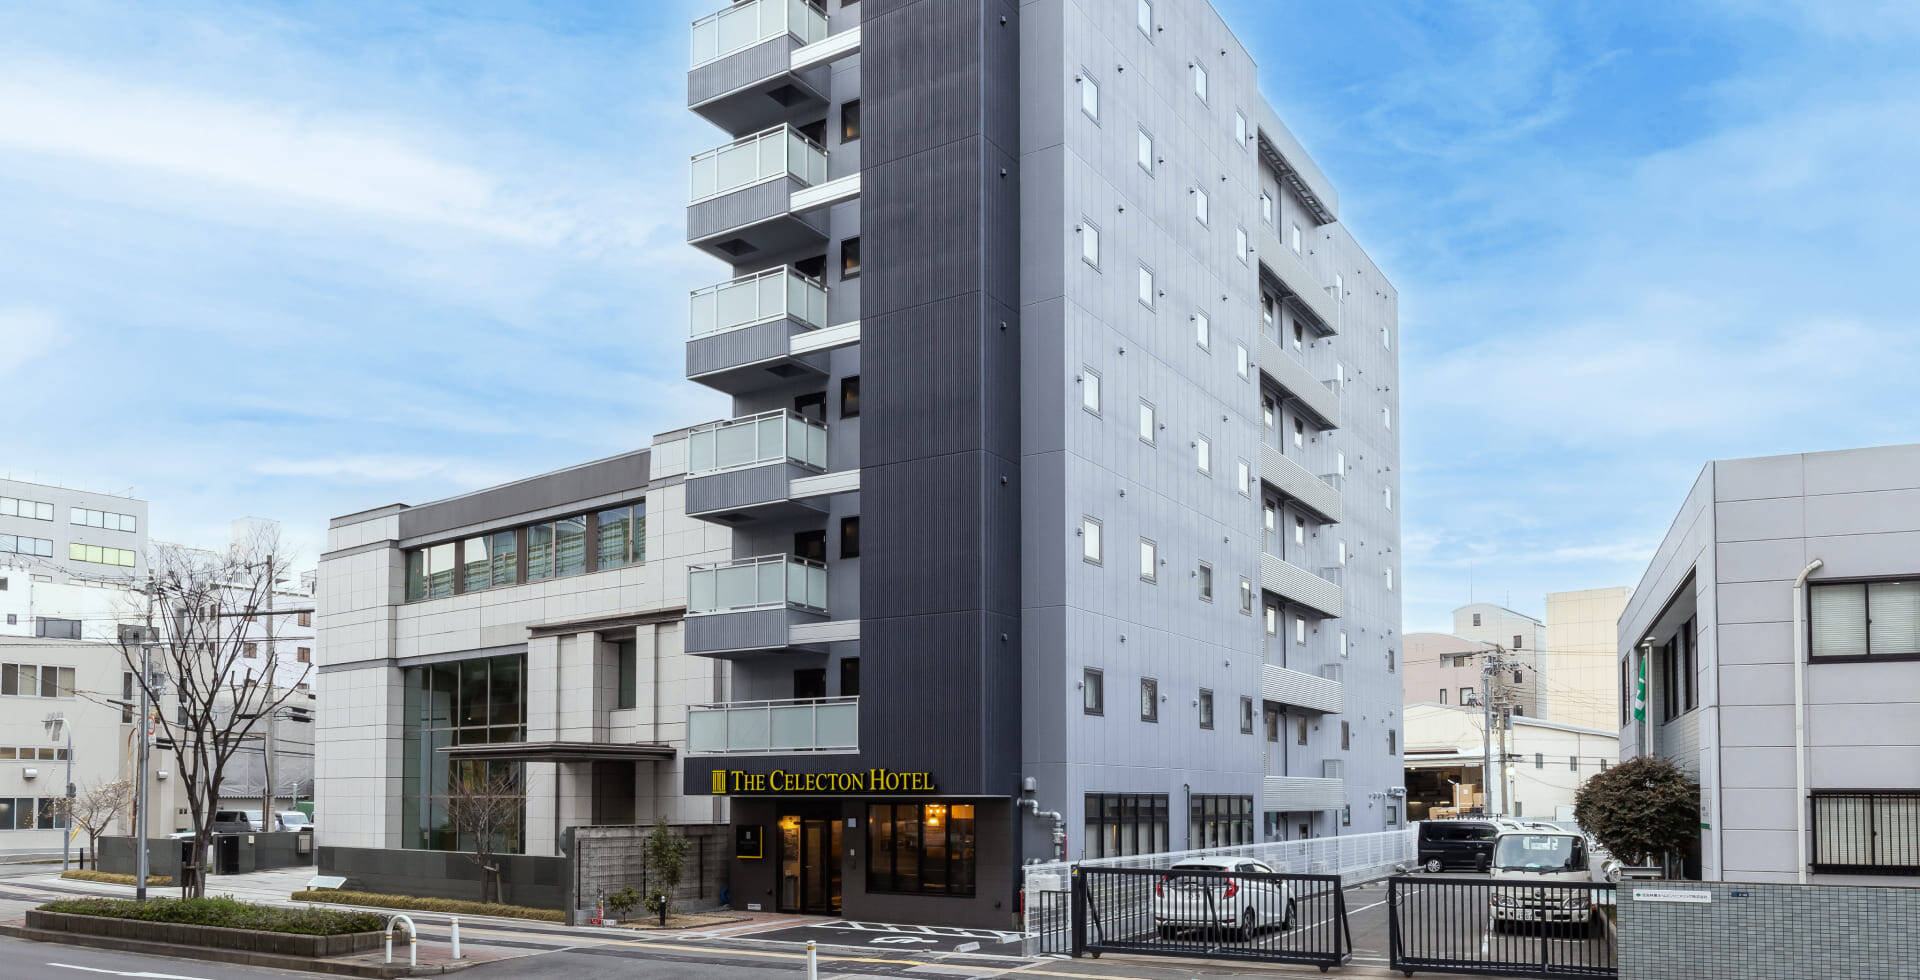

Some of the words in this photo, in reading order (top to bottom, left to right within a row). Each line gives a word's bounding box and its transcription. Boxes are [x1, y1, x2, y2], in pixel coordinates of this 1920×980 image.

[731, 770, 765, 791] THE
[769, 769, 864, 791] CELECTON
[869, 768, 935, 791] HOTEL
